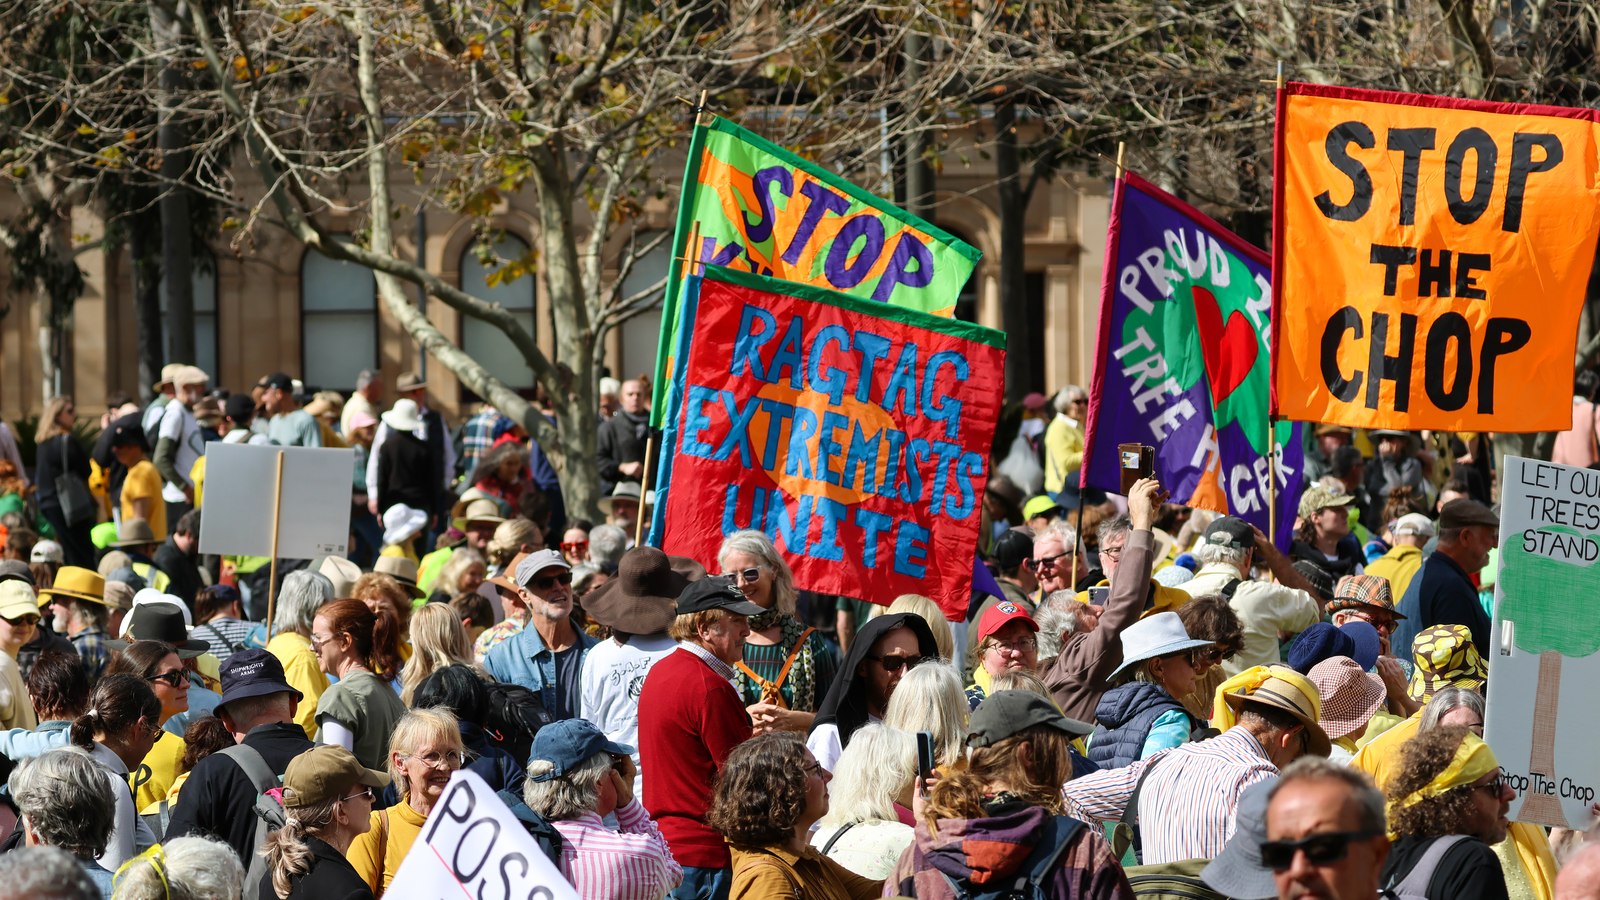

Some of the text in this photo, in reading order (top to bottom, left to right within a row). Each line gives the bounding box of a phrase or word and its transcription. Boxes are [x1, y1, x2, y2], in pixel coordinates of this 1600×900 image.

[1314, 121, 1564, 233] STOP
[742, 166, 934, 302] STOP
[1120, 228, 1230, 314] PROUD
[1370, 243, 1491, 300] THE
[729, 303, 970, 439] RAGTAG
[1113, 326, 1197, 442] TREE
[1320, 305, 1532, 415] CHOP
[681, 384, 983, 520] EXTREMISTS
[1521, 461, 1600, 500] LET OU
[721, 484, 930, 579] UNITE
[1522, 528, 1599, 561] STAND
[1525, 495, 1600, 531] TREES
[230, 661, 264, 674] SHIPWRIGHTS
[240, 669, 255, 677] ARMS
[1529, 772, 1556, 795] The
[1560, 777, 1594, 807] Chop
